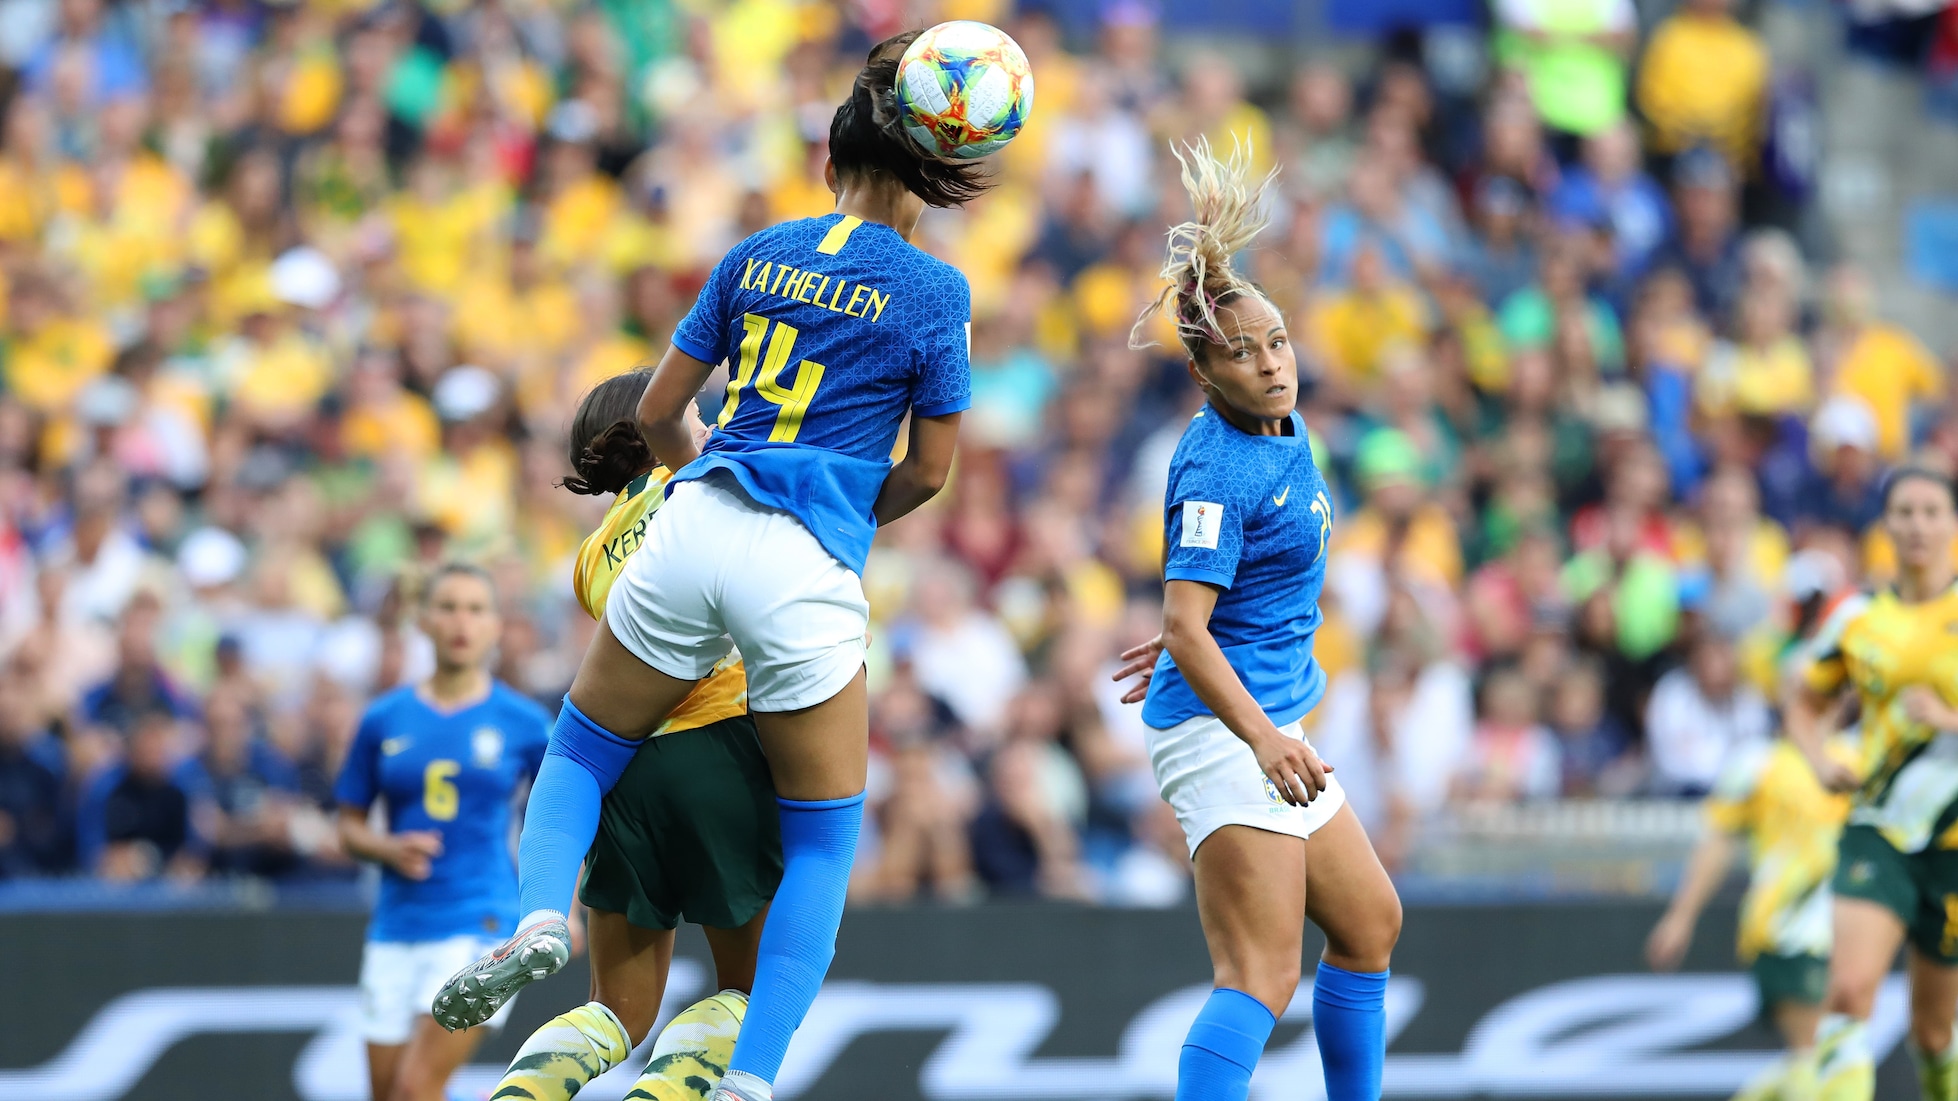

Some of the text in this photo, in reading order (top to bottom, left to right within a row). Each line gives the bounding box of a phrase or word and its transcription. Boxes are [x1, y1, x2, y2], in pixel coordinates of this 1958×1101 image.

[739, 257, 891, 323] KATHELLEN
[717, 312, 826, 443] 14
[602, 508, 659, 572] KER
[423, 758, 461, 822] 6
